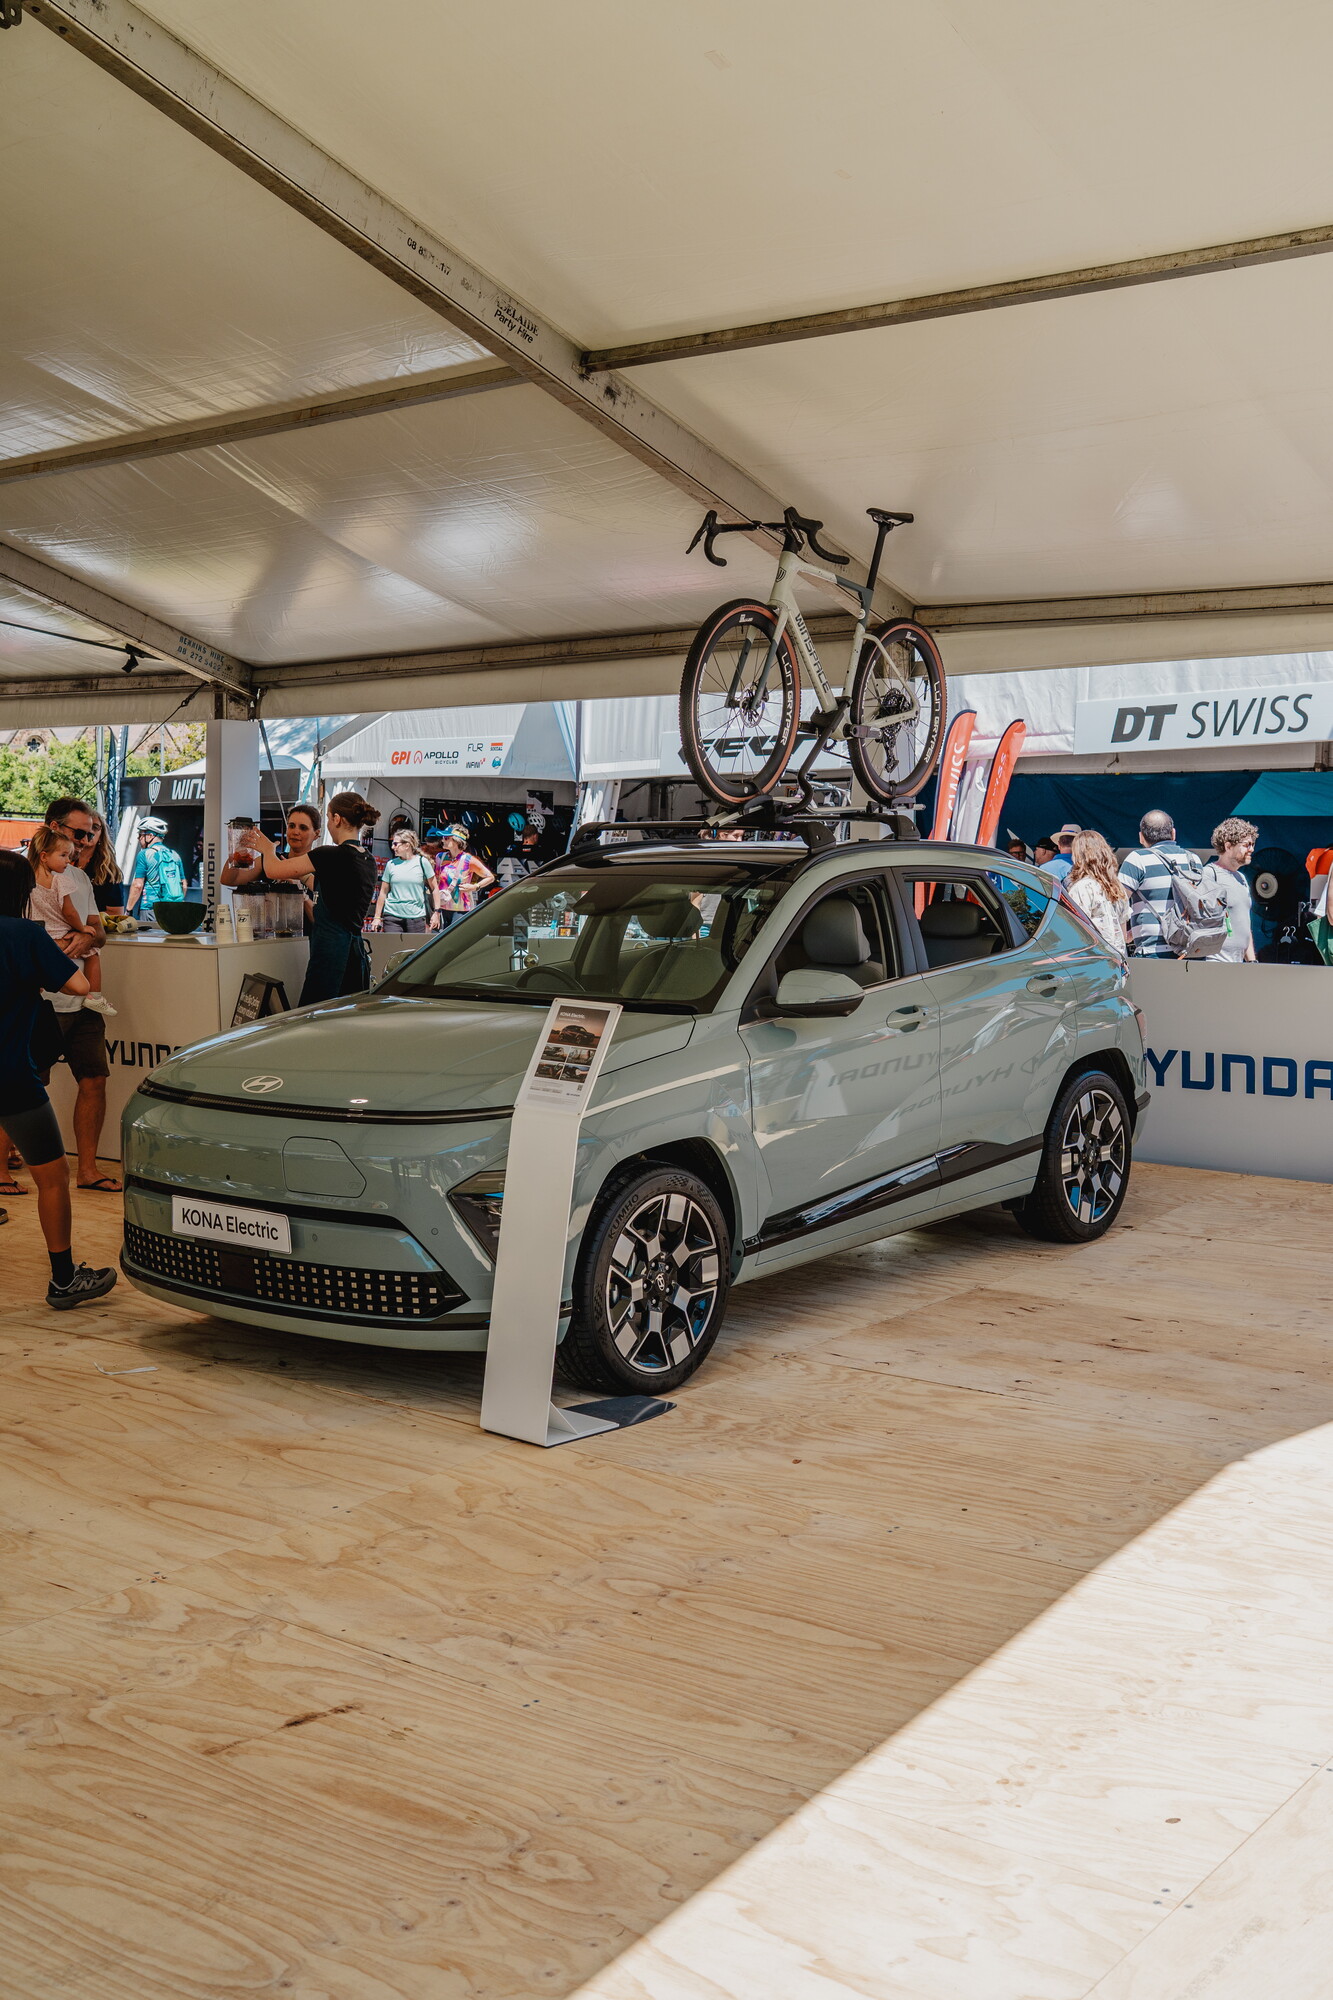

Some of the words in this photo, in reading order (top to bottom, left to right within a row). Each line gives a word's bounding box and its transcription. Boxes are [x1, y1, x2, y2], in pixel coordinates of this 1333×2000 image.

[494, 309, 516, 332] Party
[517, 325, 534, 344] Hire
[190, 652, 203, 663] 272
[210, 649, 225, 663] HIRE
[780, 690, 793, 746] GRYPER
[1110, 703, 1178, 743] DT
[1186, 693, 1313, 739] SWISS
[391, 751, 411, 765] GPI
[424, 751, 459, 759] APOLLO
[924, 716, 940, 763] GRYPER
[207, 843, 215, 922] HYUNDAI
[105, 1039, 182, 1068] YUND
[1147, 1047, 1333, 1100] YUNDA
[181, 1207, 223, 1231] KONA
[226, 1215, 279, 1240] Electric
[608, 1194, 639, 1240] KUMHO
